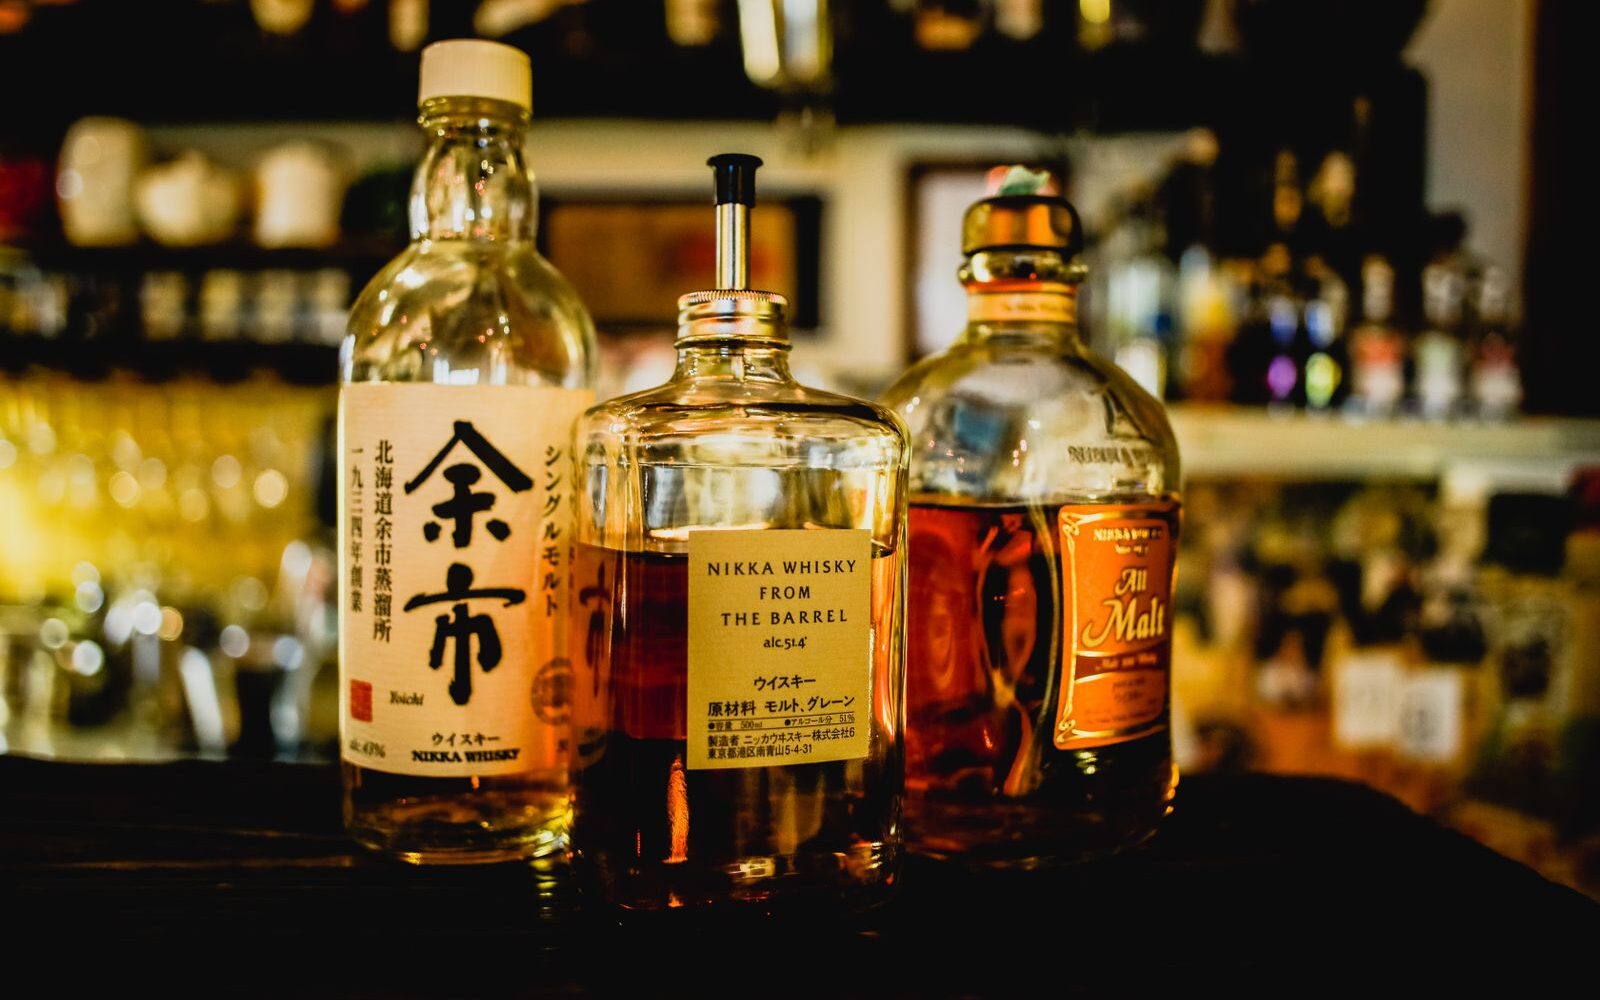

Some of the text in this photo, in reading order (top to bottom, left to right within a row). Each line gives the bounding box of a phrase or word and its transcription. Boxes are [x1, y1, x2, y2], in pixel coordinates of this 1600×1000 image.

[543, 445, 562, 618] シングルモルト
[403, 420, 535, 707] 余市
[708, 559, 856, 576] NIKKA WHISKY
[1114, 568, 1148, 596] All
[759, 585, 811, 600] FROM
[721, 609, 848, 626] THE BARREL
[1081, 596, 1164, 648] Malt
[753, 673, 817, 692] ウイスキー
[707, 700, 757, 717] 原材料
[431, 731, 501, 748] ウイスキー
[411, 748, 522, 764] NIKKA WHISKY
